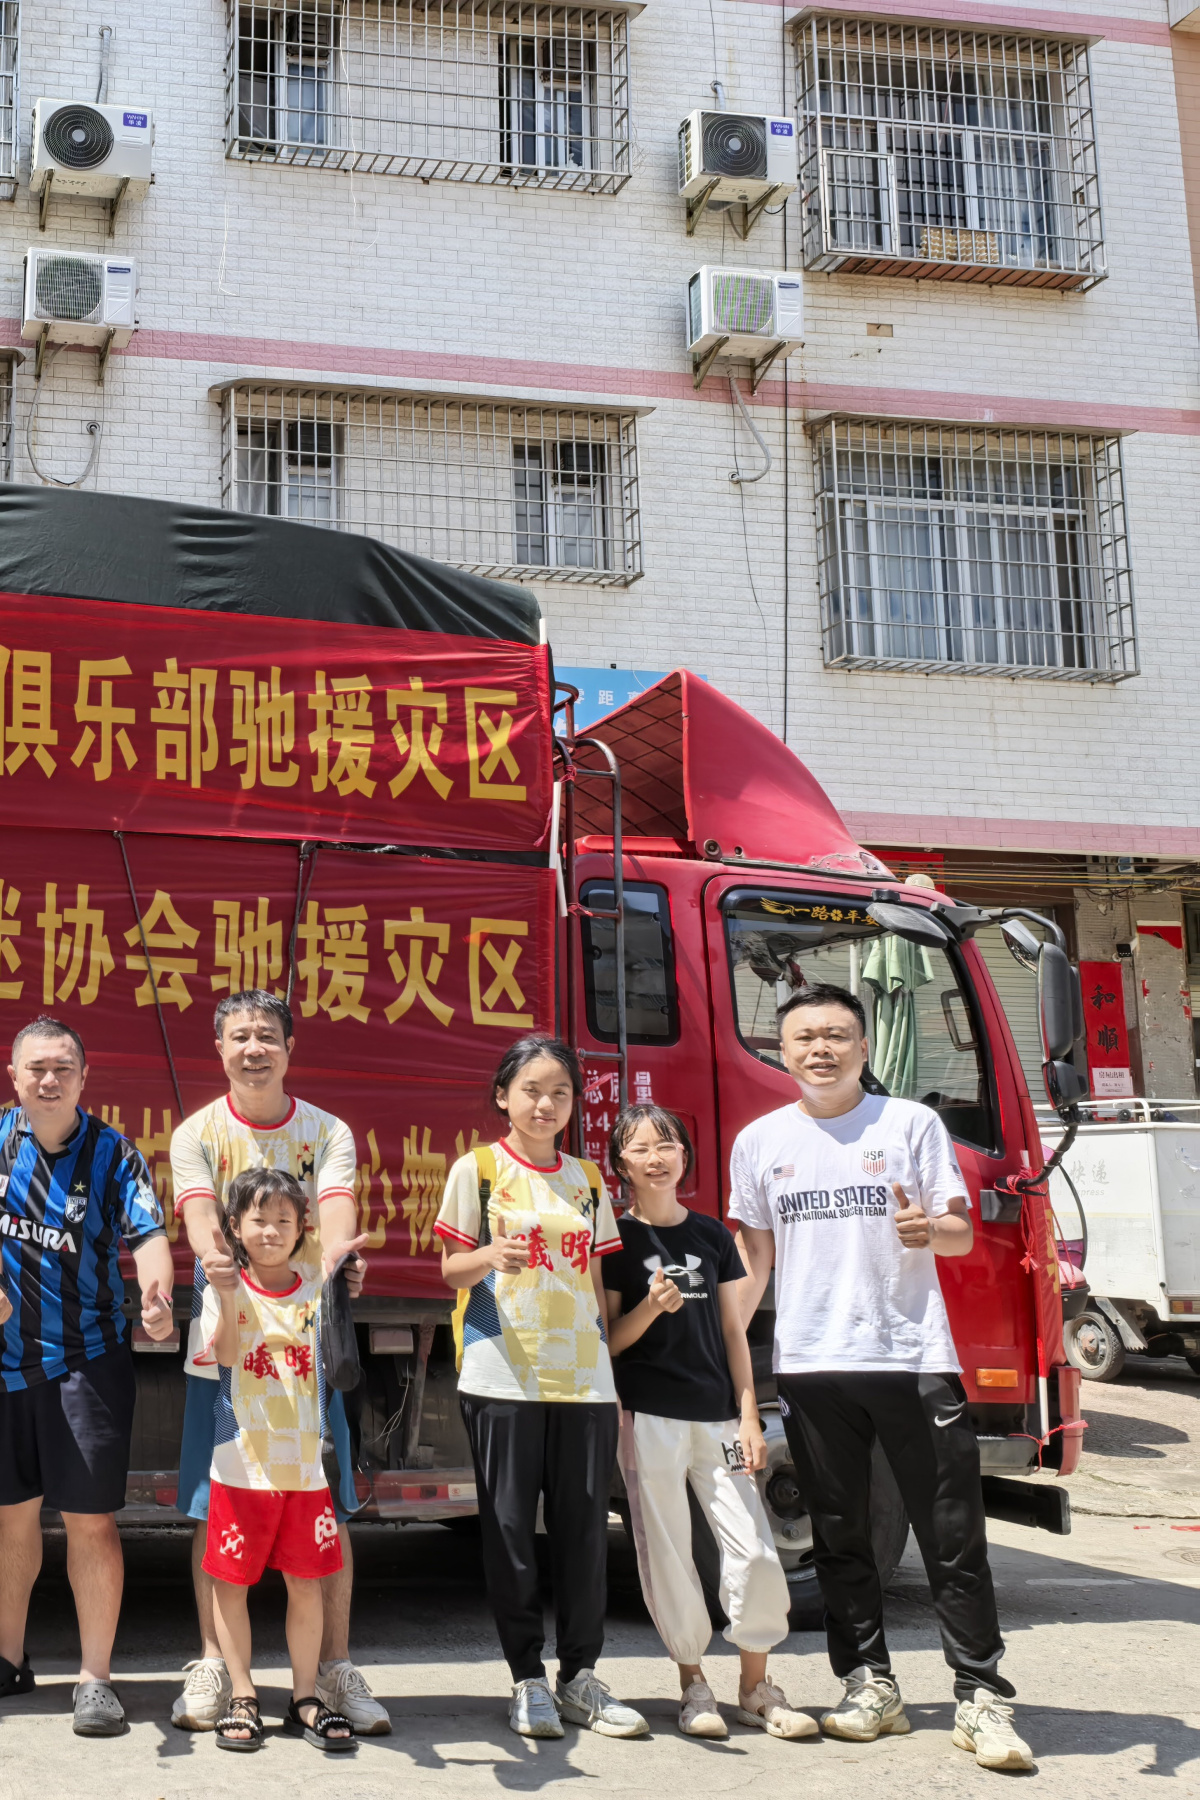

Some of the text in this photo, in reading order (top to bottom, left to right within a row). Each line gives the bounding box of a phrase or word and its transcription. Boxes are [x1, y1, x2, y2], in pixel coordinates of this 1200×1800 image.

[863, 1150, 884, 1161] USA
[777, 1185, 887, 1215] UNITED STATES
[802, 1209, 838, 1222] NATIONAL
[864, 1206, 887, 1217] TEAM
